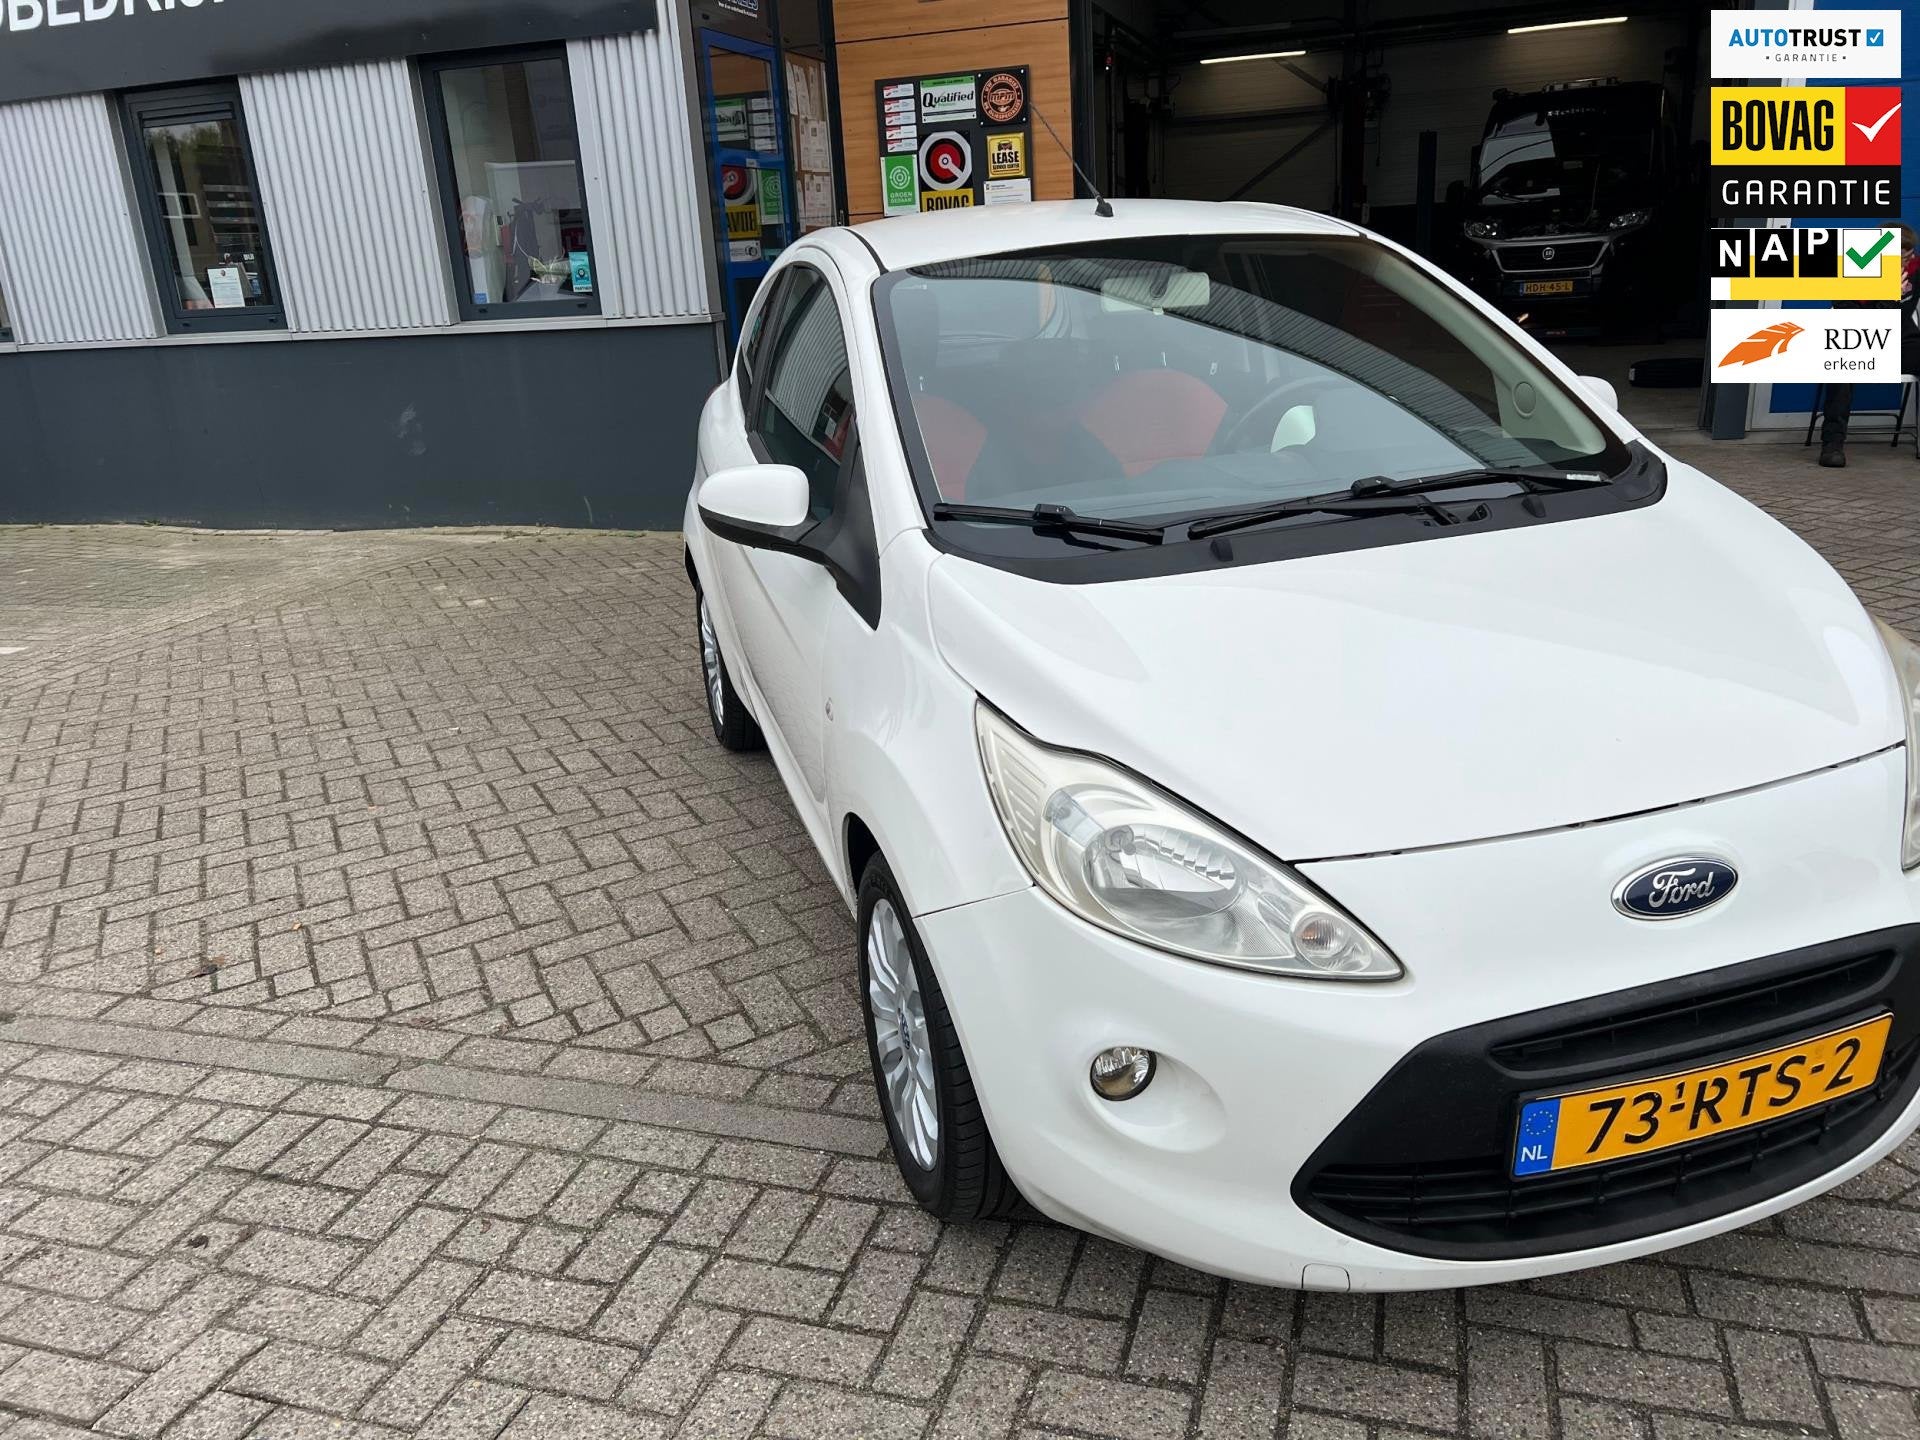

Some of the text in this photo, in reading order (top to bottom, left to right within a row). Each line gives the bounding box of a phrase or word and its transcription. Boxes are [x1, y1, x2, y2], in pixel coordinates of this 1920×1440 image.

[922, 90, 974, 108] Qualified
[992, 151, 1019, 164] LEASE
[1526, 282, 1570, 292] HDH-45-L
[1648, 867, 1714, 908] Ford
[1520, 1037, 1861, 1162] NL 73-RTS-2
